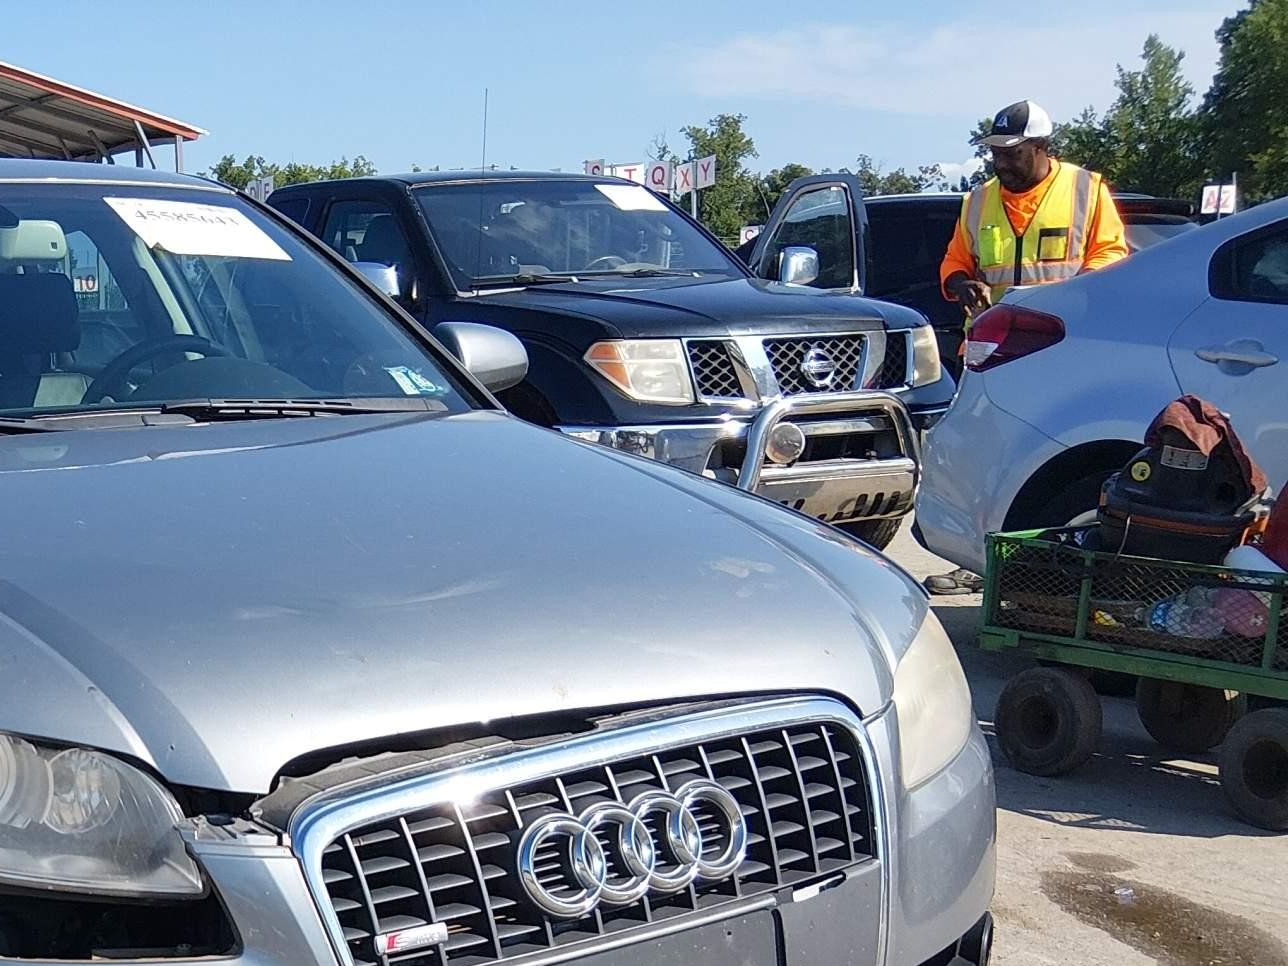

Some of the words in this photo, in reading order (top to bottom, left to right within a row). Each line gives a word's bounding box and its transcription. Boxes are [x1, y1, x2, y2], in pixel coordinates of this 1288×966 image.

[651, 166, 666, 186] Q
[680, 168, 690, 189] X
[701, 161, 711, 182] Y
